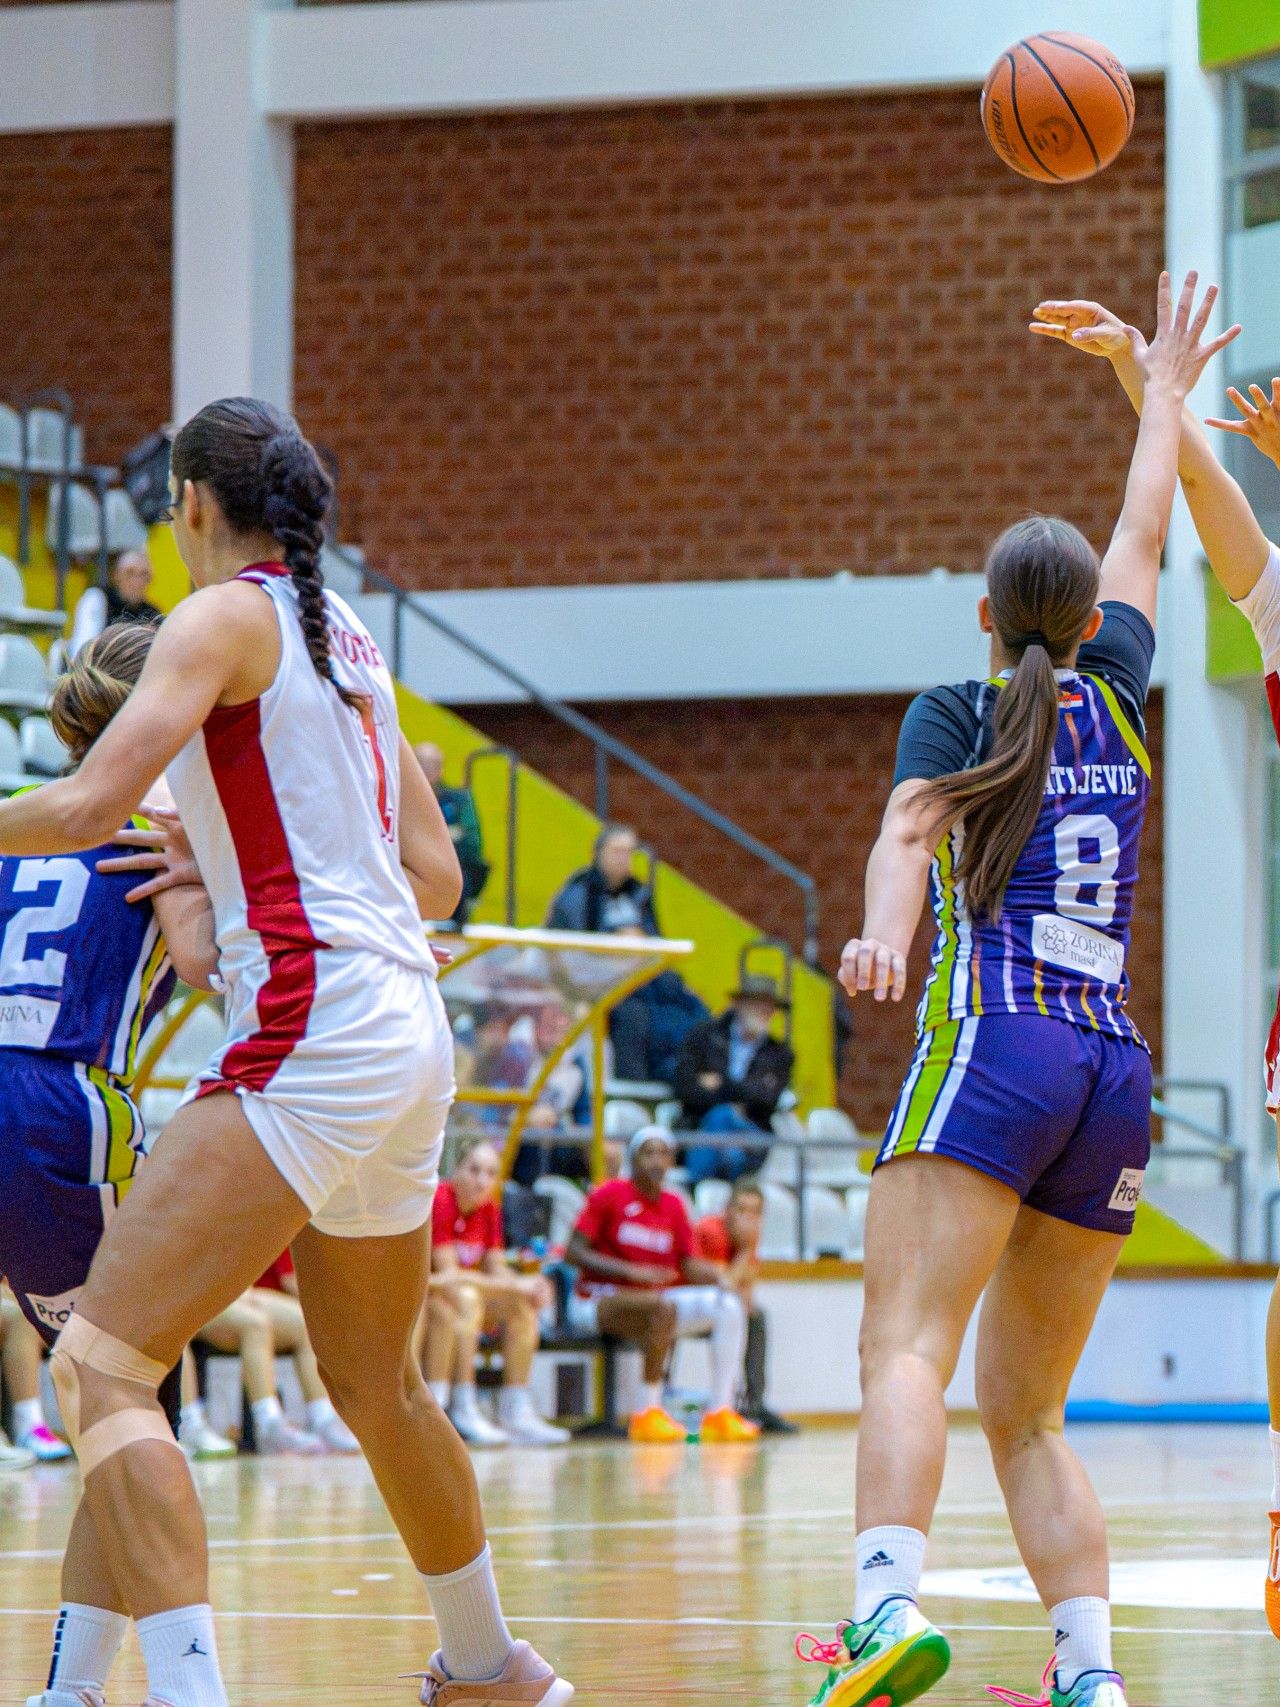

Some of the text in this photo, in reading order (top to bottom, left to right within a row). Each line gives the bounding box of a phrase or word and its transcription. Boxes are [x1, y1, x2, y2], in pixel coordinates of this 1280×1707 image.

[0, 857, 92, 988] 2
[1053, 814, 1121, 928] 8
[1069, 930, 1120, 967] ZORINA
